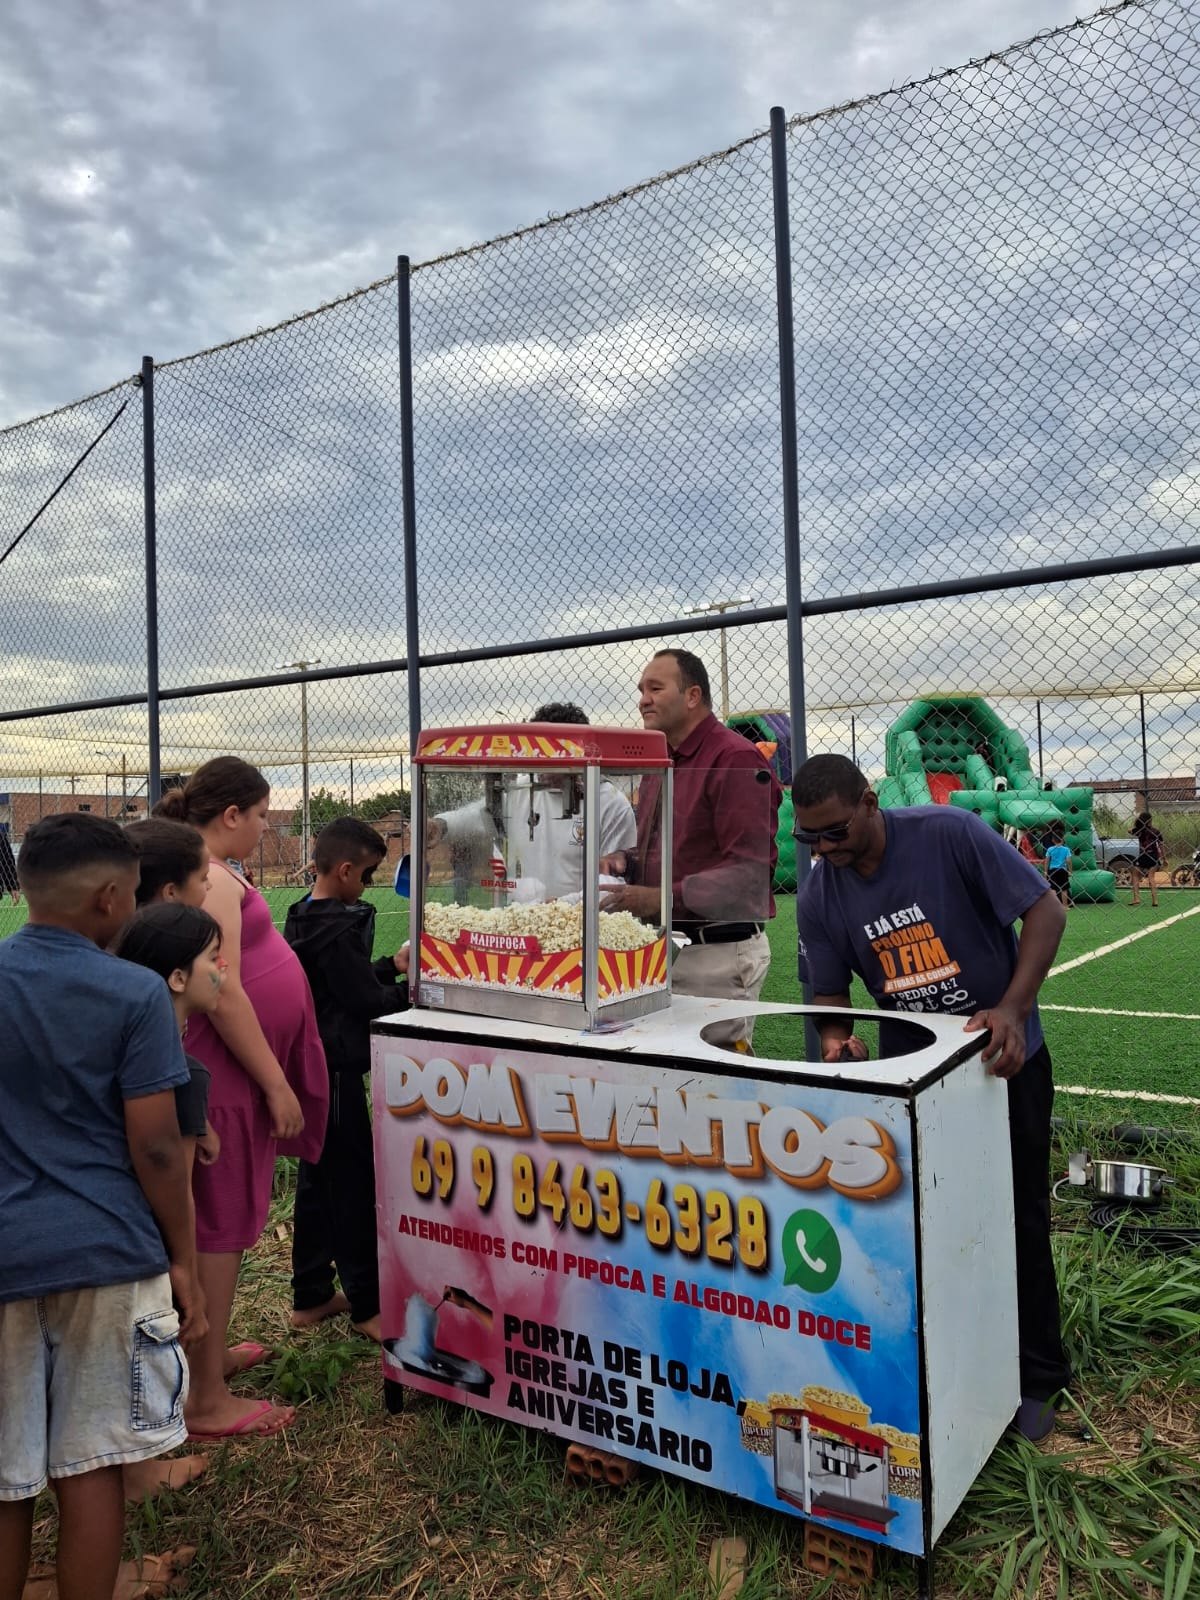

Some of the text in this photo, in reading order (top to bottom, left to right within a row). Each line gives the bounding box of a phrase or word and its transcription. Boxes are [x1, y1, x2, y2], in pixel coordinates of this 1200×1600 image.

[470, 932, 527, 950] MAIPIPOCA
[864, 902, 927, 940] E JÁ ESTÁ
[879, 937, 950, 979] O FIM
[897, 984, 938, 1001] PEDRO
[940, 977, 959, 992] 4:7
[385, 1052, 902, 1199] DOM EVENTOS
[410, 1135, 768, 1270] 69 9 8463-6328
[399, 1214, 872, 1352] ATENDEMOS COM PIPOCA E ALGODAO DOCE
[503, 1313, 747, 1416] PORTA DE LOJA,
[504, 1347, 655, 1419] IGREJAS E
[506, 1381, 713, 1474] ANIVERSARIO
